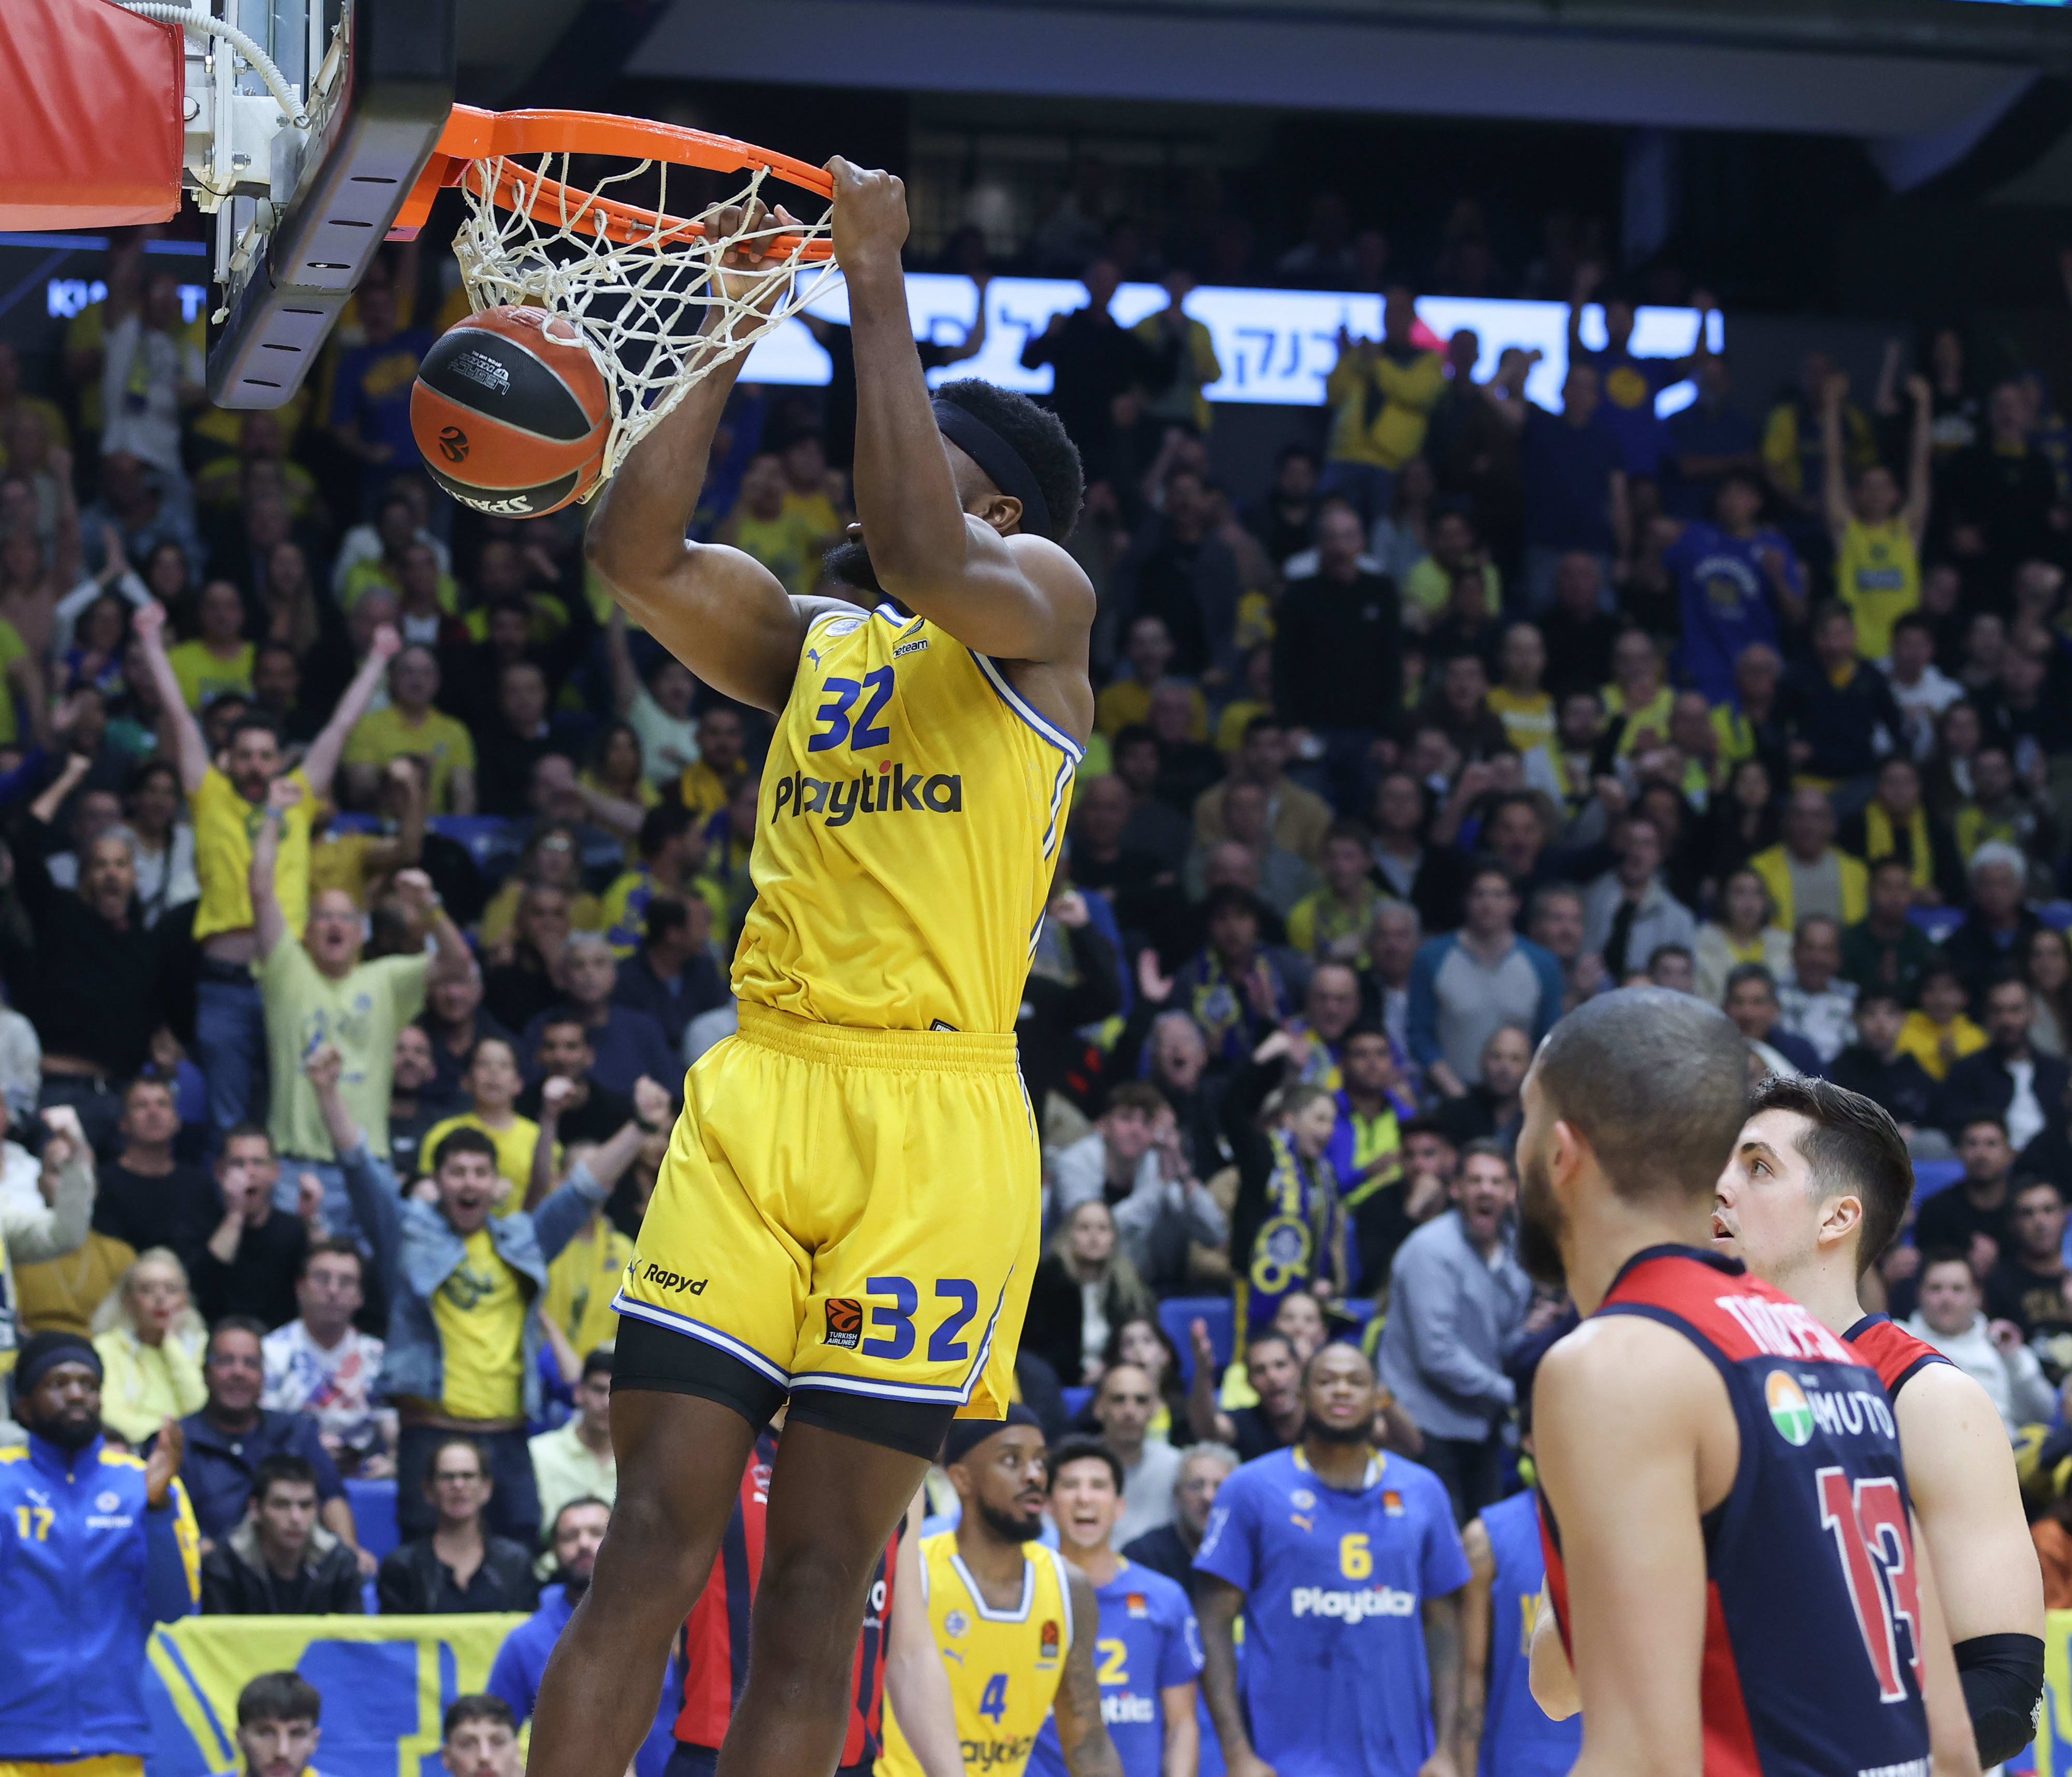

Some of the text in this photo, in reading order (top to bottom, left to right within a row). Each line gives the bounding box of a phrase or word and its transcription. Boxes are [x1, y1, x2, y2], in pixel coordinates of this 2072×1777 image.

[808, 665, 895, 753] 32
[771, 759, 962, 827] Playtika
[643, 1263, 709, 1296] Rapyd
[829, 1331, 858, 1340] TURKISH
[862, 1276, 978, 1362] 32
[827, 1338, 856, 1346] AIRLINES
[15, 1505, 55, 1541] 17
[1340, 1533, 1373, 1580] 6
[1291, 1584, 1416, 1624] Playtika
[979, 1673, 1009, 1725] 4
